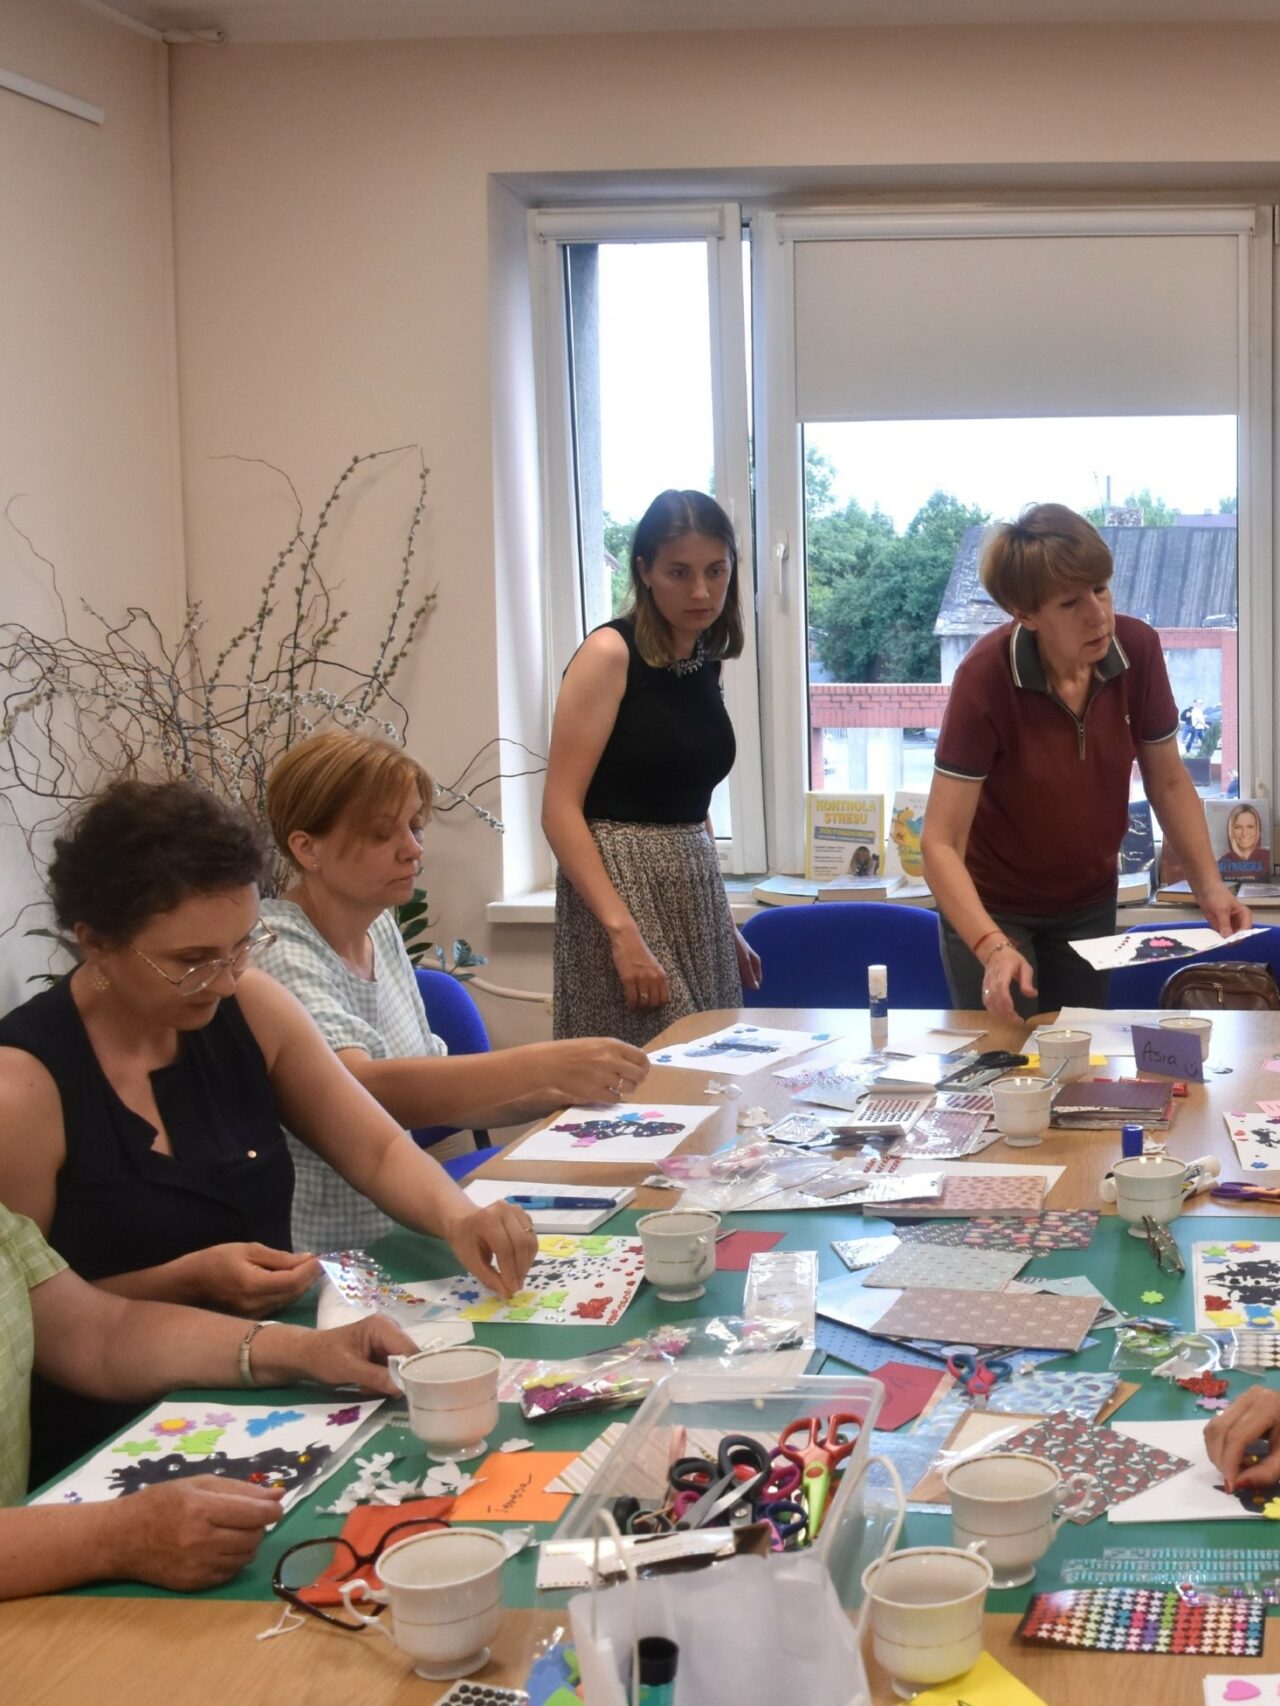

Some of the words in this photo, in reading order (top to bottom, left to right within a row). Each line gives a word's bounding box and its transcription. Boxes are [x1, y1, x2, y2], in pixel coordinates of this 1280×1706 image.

[815, 799, 876, 812] KONTROLA
[824, 812, 869, 825] STRESU
[1142, 1040, 1178, 1067] Asia
